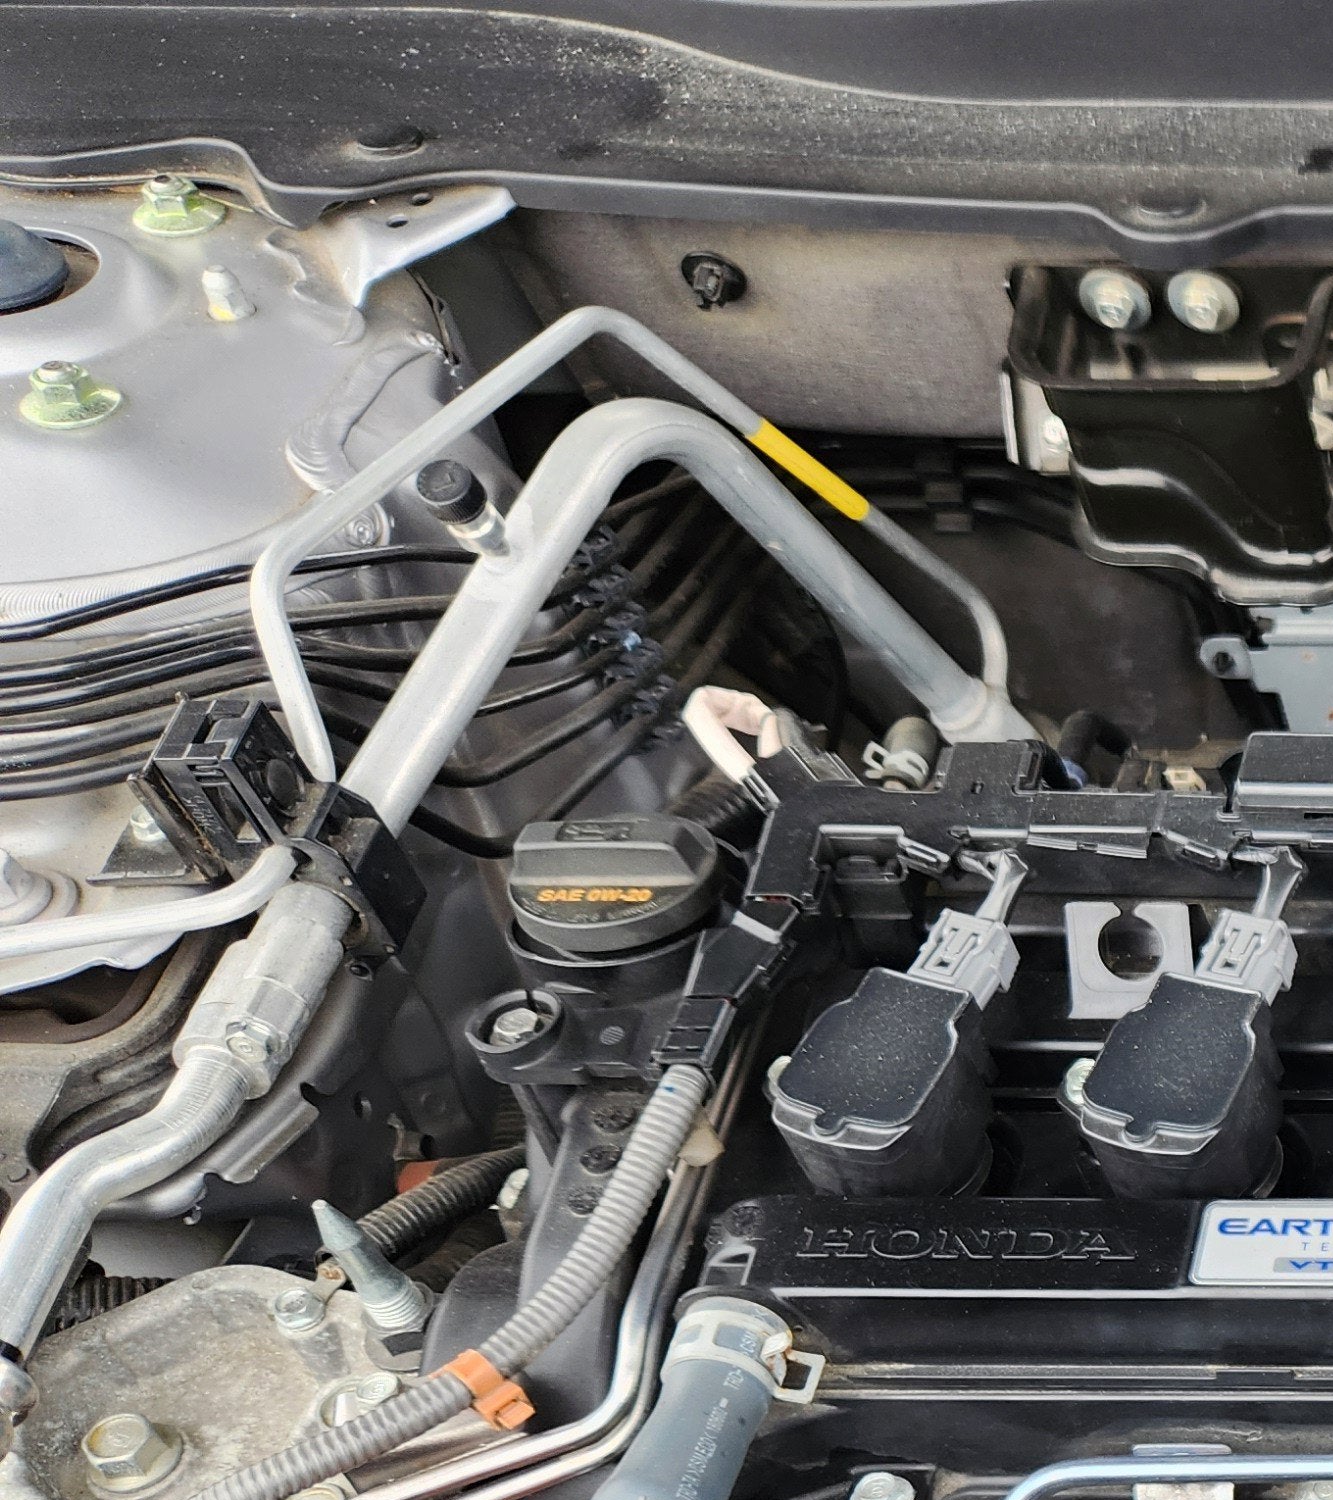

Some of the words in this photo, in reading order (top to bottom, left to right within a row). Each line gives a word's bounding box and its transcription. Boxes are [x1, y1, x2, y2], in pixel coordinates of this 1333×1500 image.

[537, 887, 586, 903] SAE
[586, 886, 655, 903] 0W-20
[795, 1226, 1138, 1260] HONDA
